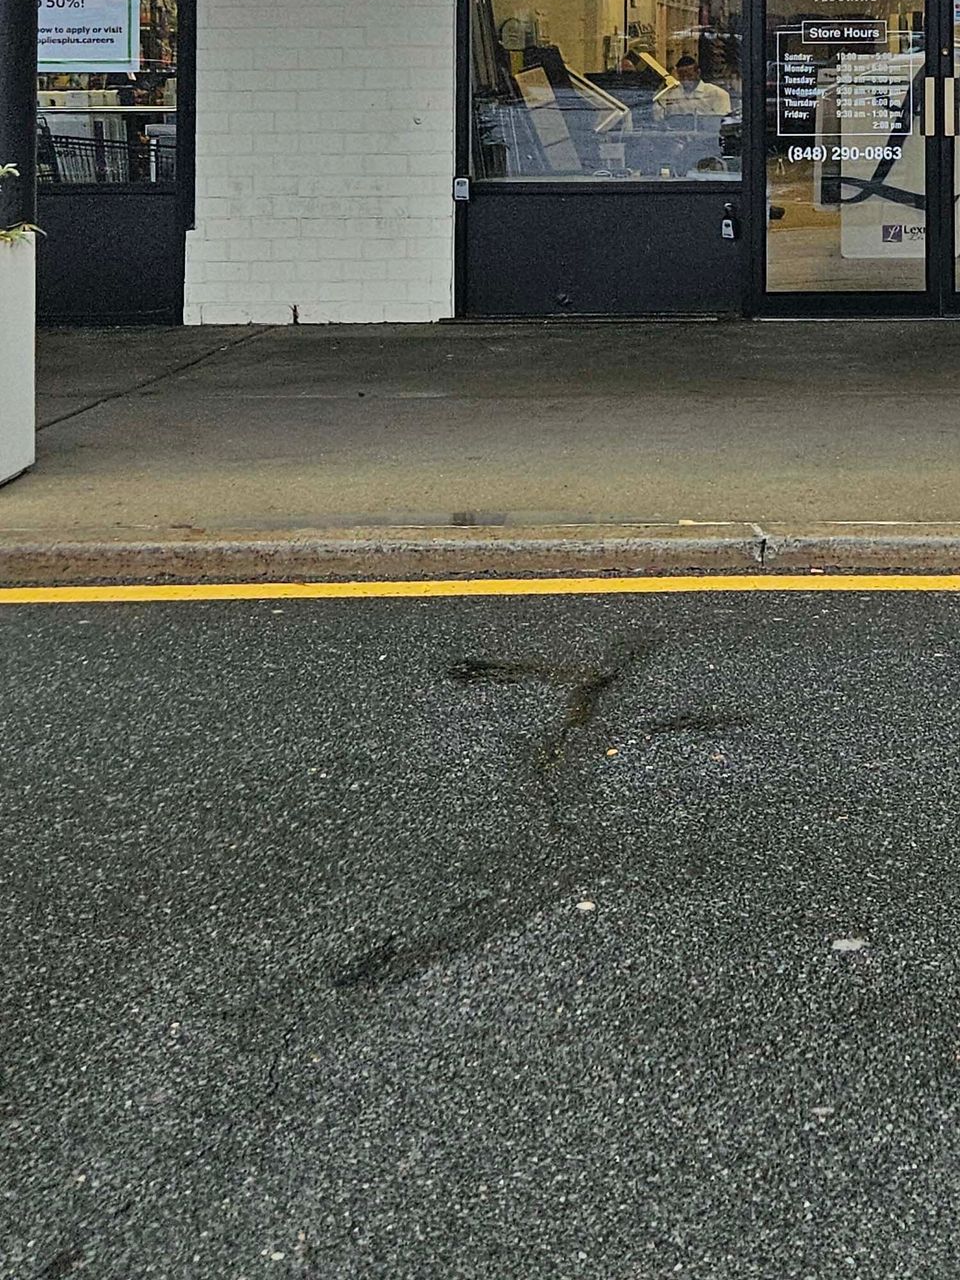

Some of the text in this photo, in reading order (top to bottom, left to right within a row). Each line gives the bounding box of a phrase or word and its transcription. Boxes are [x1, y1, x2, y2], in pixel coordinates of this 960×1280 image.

[66, 27, 90, 35] apply
[104, 26, 123, 34] visit
[809, 27, 880, 38] Store Hours
[784, 53, 813, 62] Sunday:
[784, 64, 815, 73] Monday:
[784, 76, 816, 85] Tuesday:
[784, 99, 819, 108] Thursday:
[784, 110, 810, 119] Friday:
[788, 145, 902, 163] (848) 290-0863
